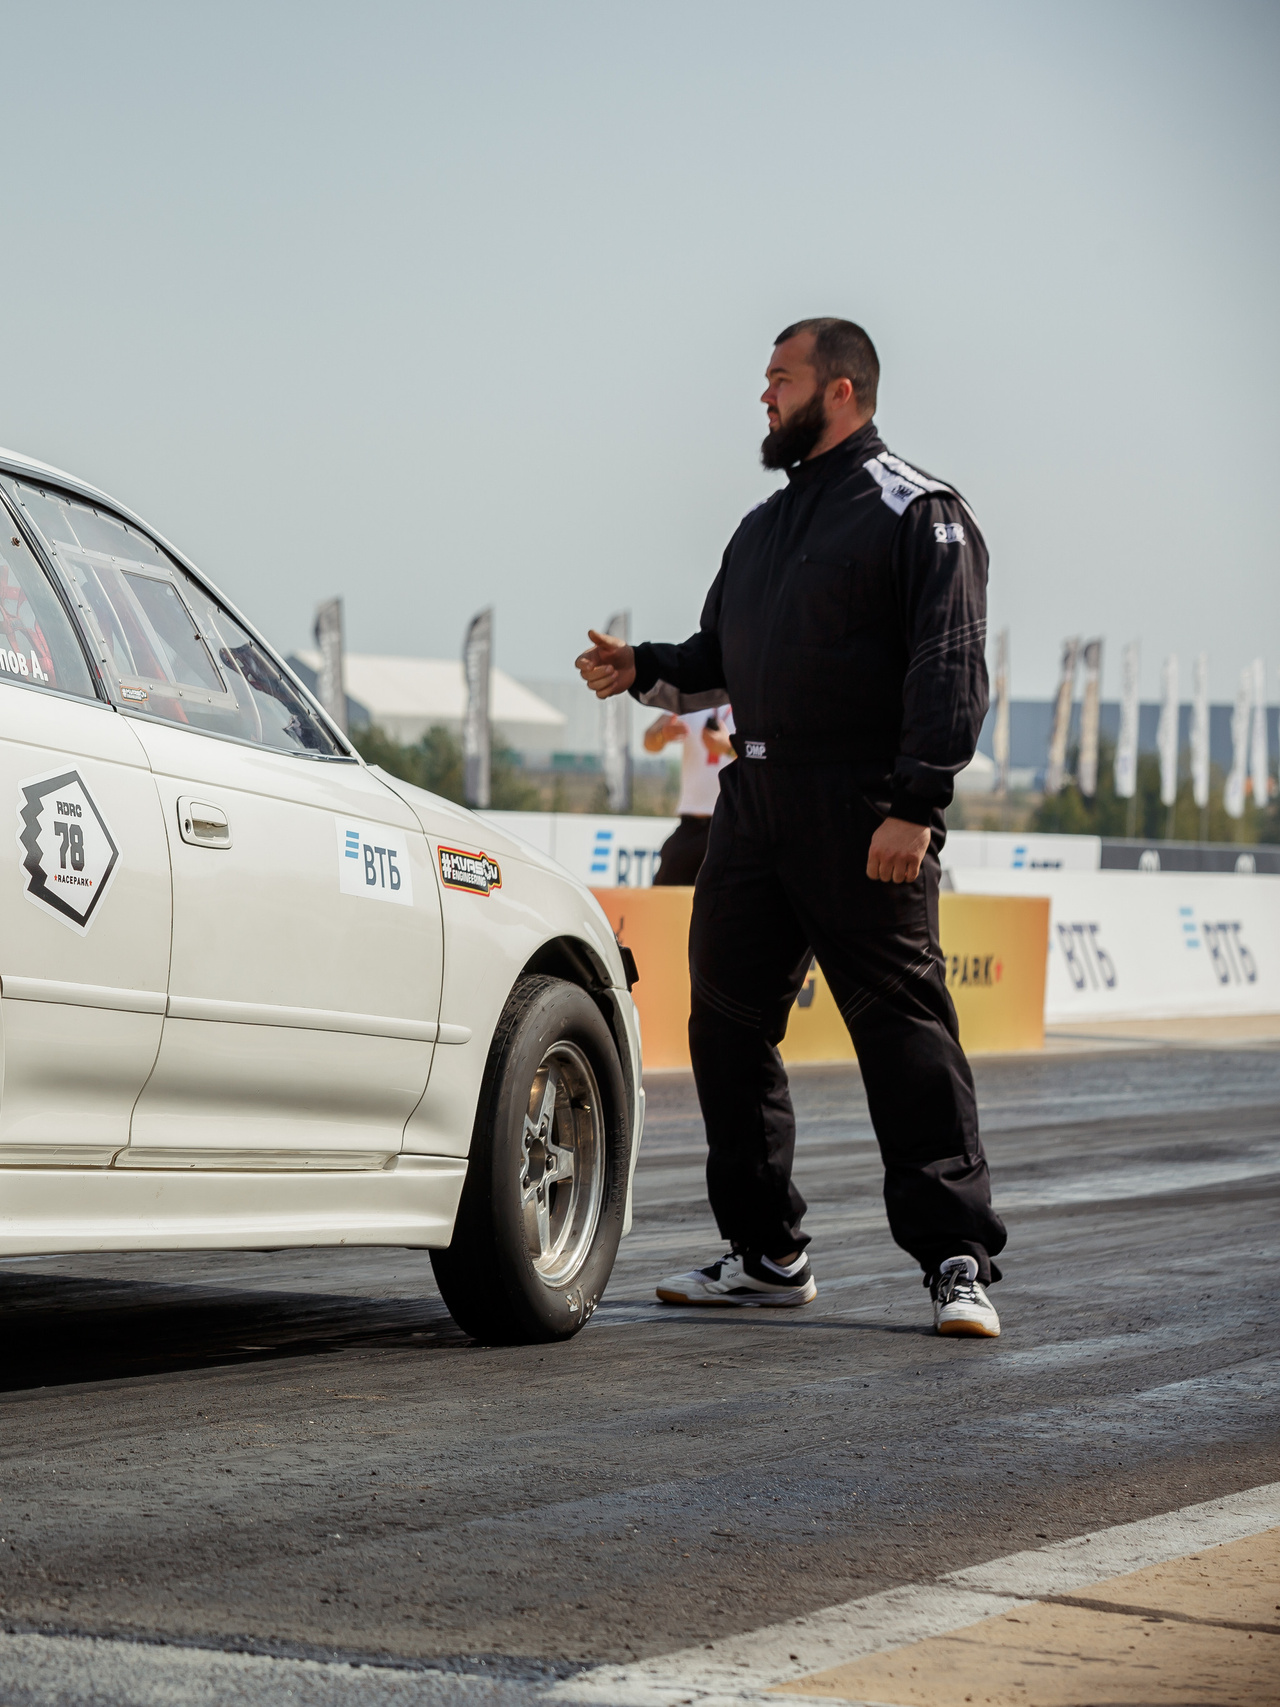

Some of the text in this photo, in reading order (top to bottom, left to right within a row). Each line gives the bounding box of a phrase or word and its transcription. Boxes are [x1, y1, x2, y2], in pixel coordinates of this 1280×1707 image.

[30, 650, 49, 682] А.
[745, 744, 766, 757] OMP
[56, 801, 82, 818] RDRC
[54, 821, 85, 871] 78
[58, 874, 89, 887] RACEPARK
[363, 844, 401, 891] ВТБ
[452, 869, 487, 887] ENGINEERING
[1057, 922, 1116, 990] ВТБ
[1202, 921, 1257, 985] ВТБ
[944, 955, 993, 987] PARK
